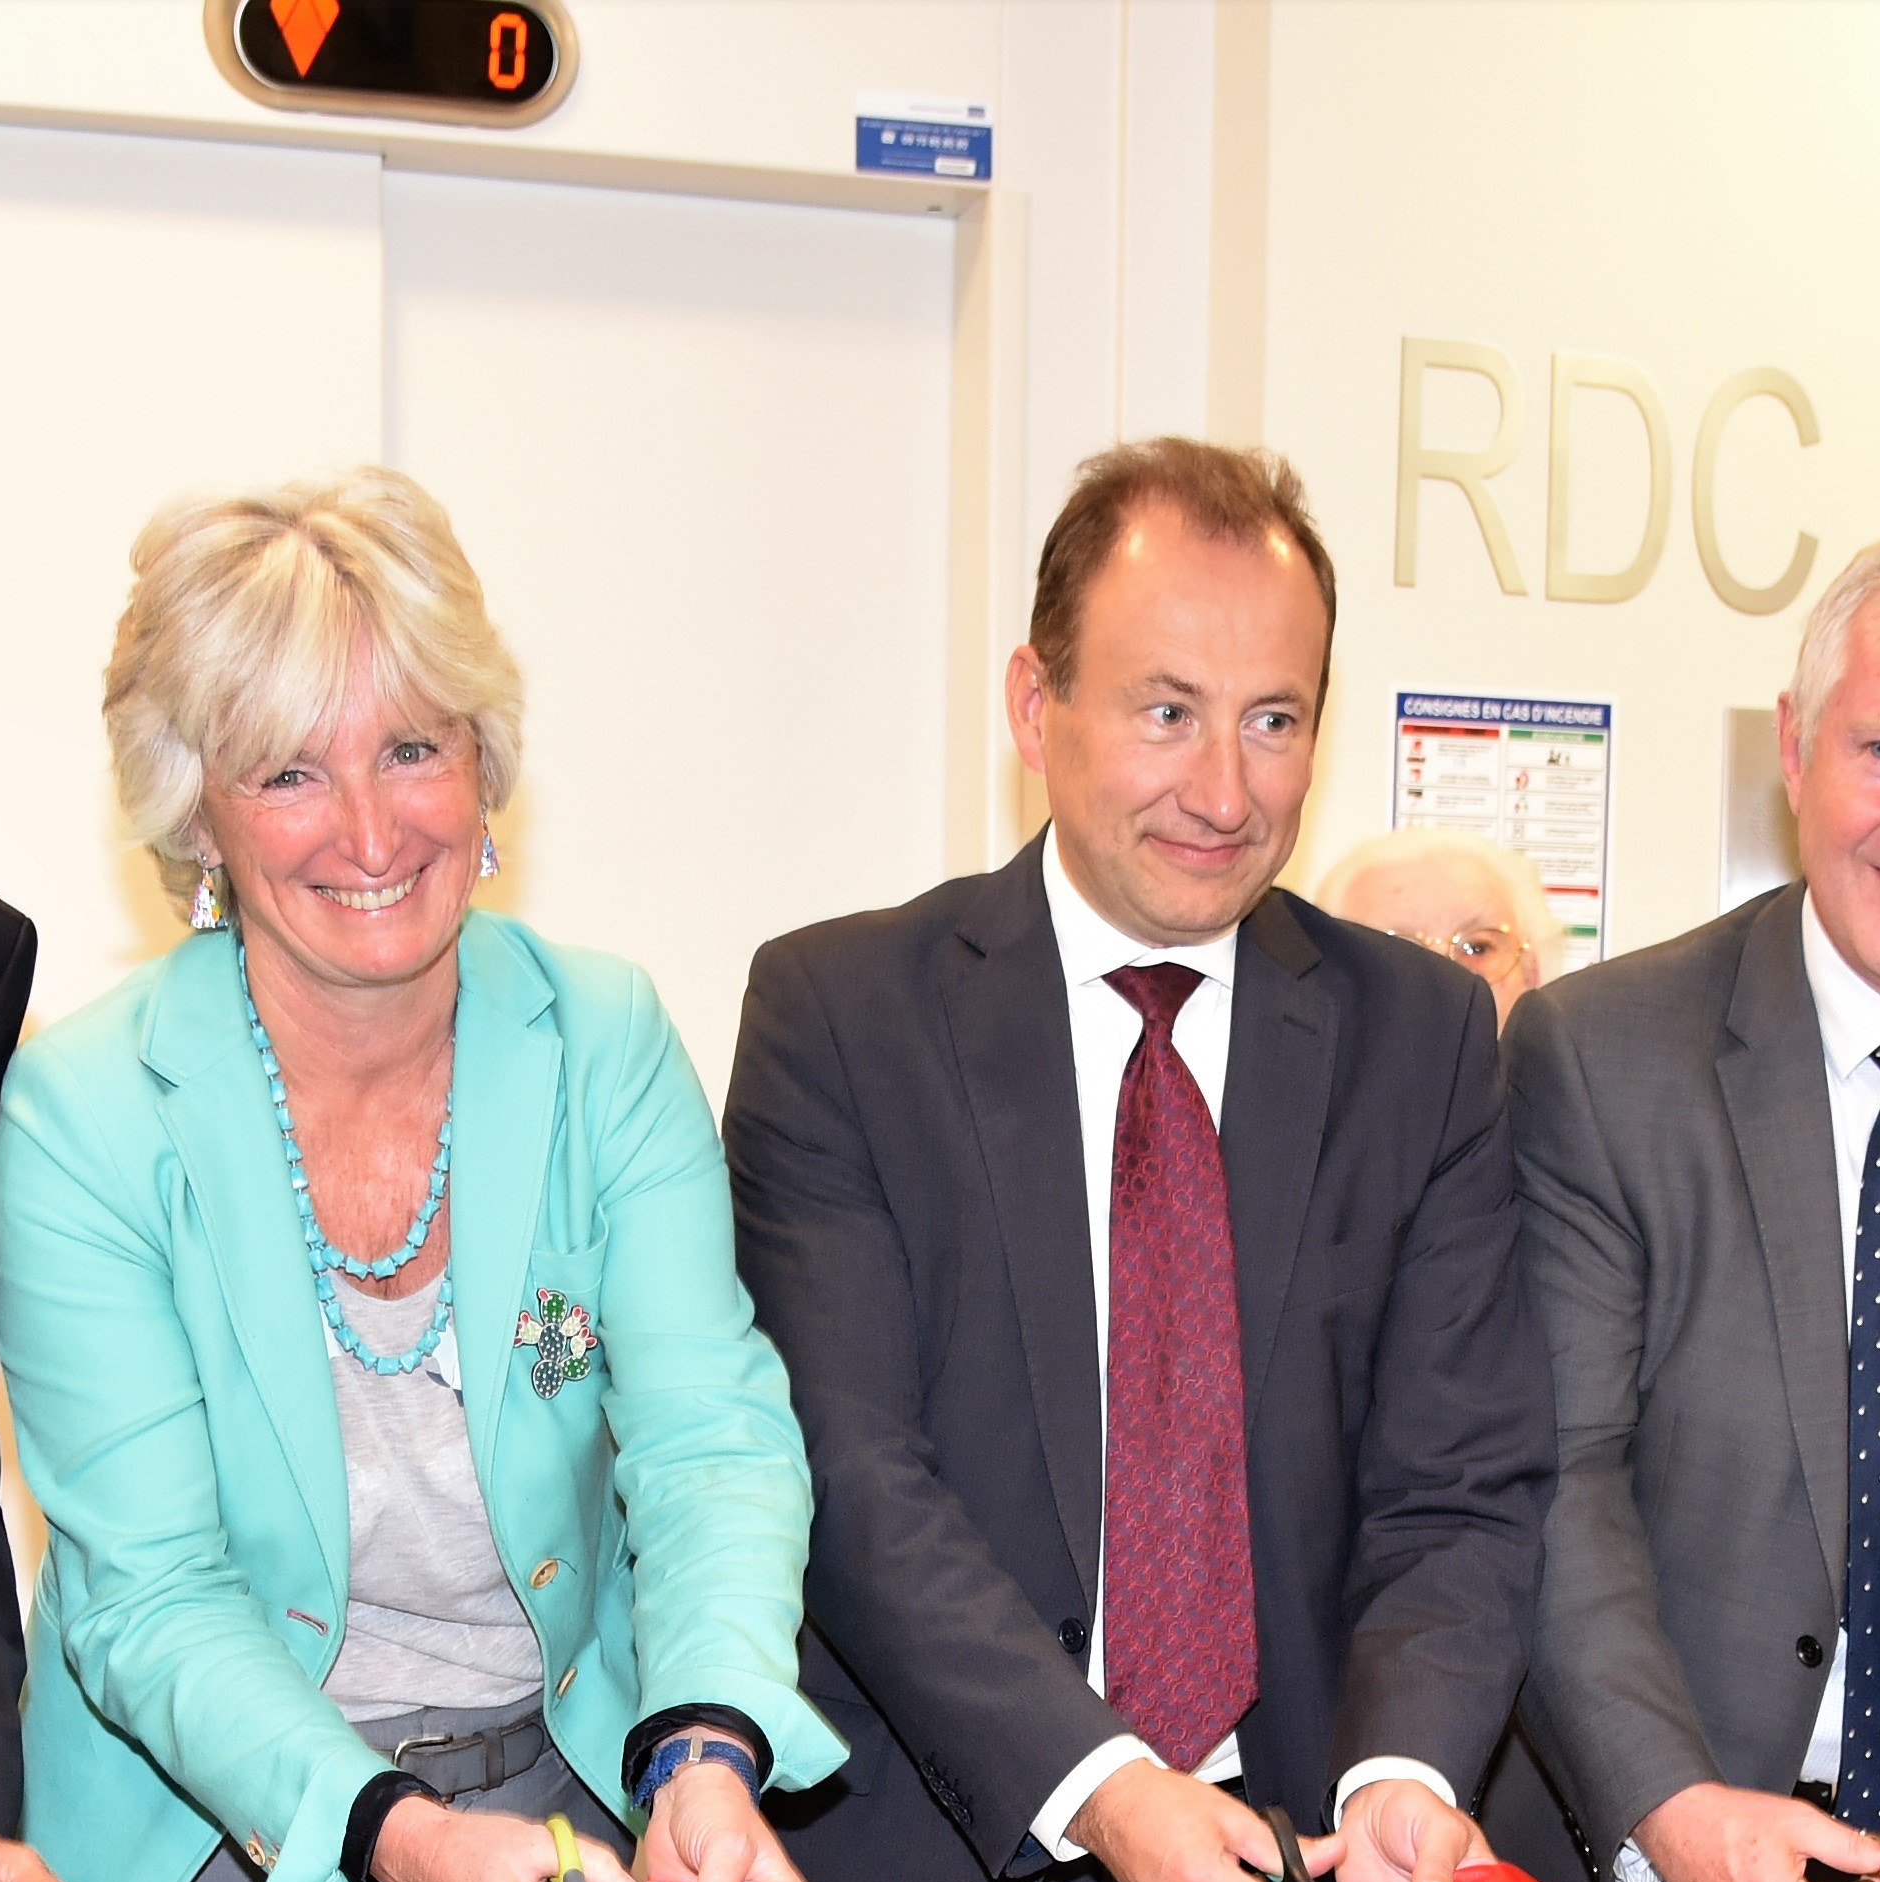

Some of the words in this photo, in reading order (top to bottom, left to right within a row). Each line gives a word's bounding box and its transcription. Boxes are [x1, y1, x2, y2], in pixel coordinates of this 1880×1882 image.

[488, 12, 527, 90] 0
[1393, 336, 1821, 616] RDC
[1404, 697, 1481, 718] CONSIGNES
[1482, 701, 1502, 720] EN
[1503, 702, 1530, 722] CAS
[1531, 705, 1603, 725] D'INCENDIE
